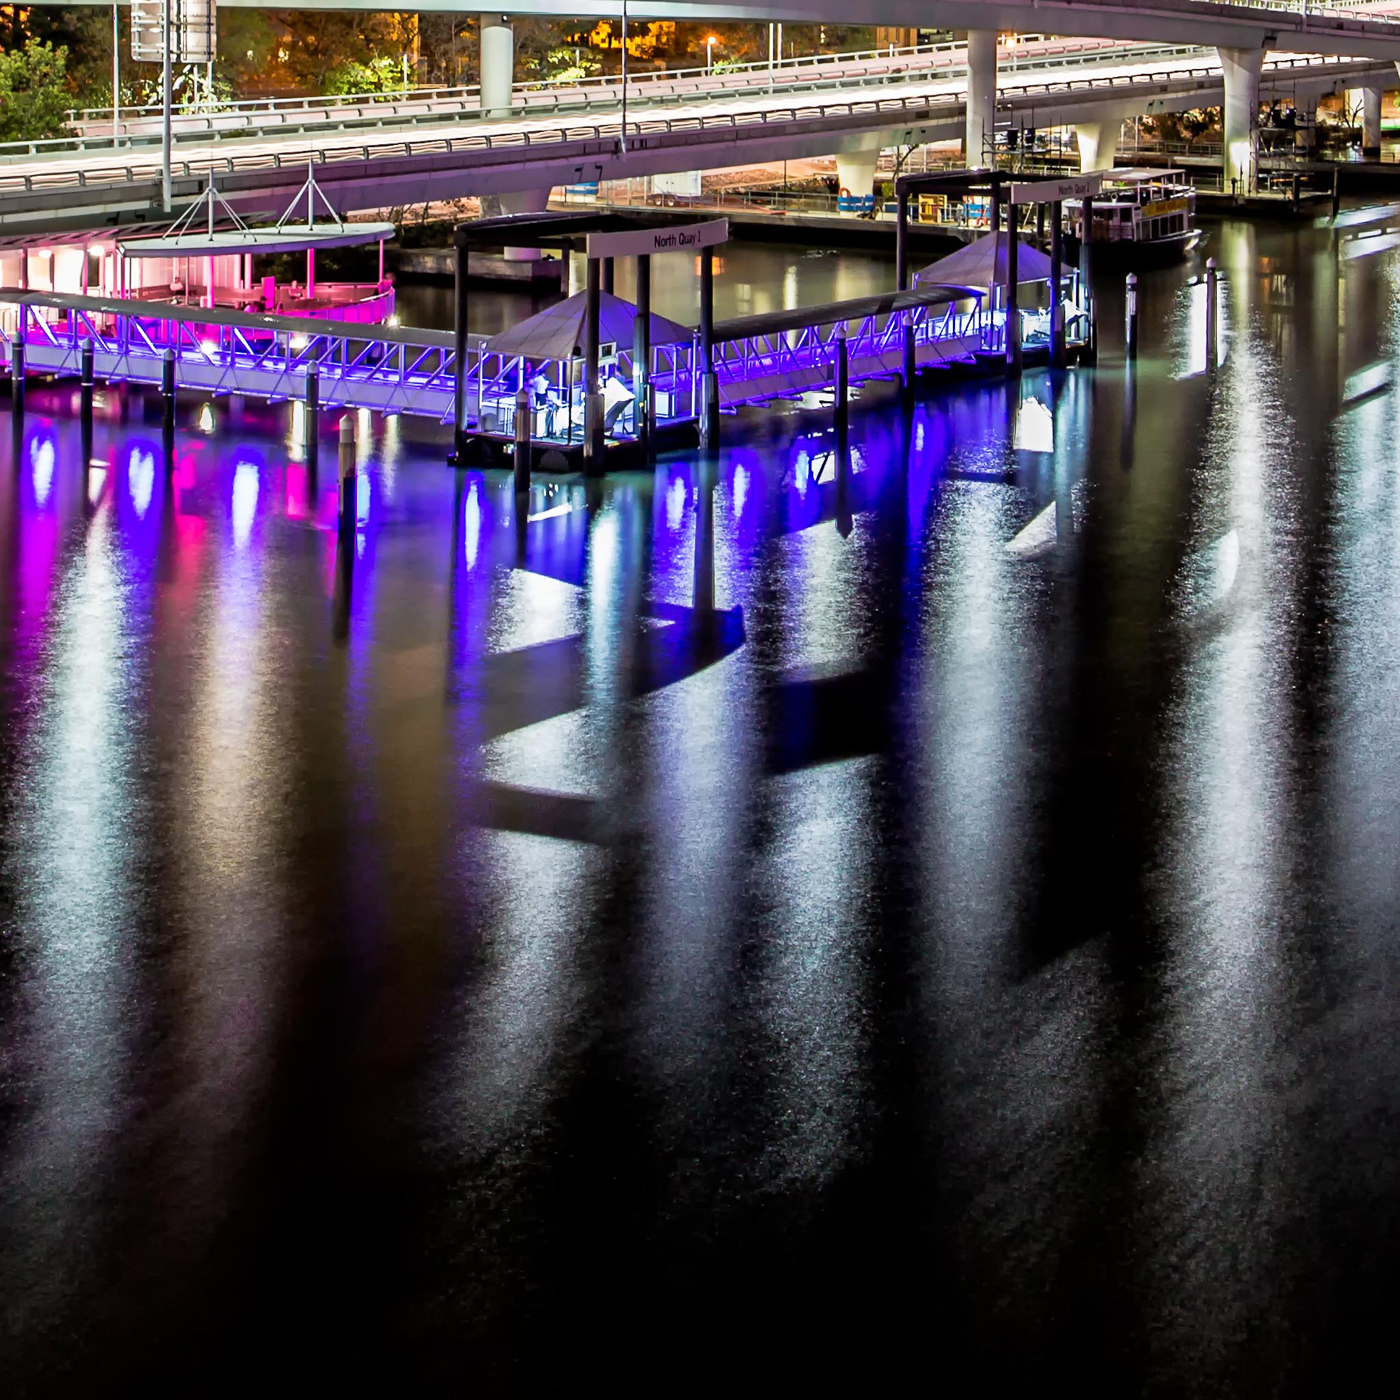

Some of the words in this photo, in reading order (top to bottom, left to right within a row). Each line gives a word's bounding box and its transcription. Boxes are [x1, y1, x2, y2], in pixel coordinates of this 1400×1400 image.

[1058, 184, 1073, 196] North
[1074, 183, 1086, 195] Quay
[654, 234, 676, 248] North
[679, 232, 695, 246] Quay
